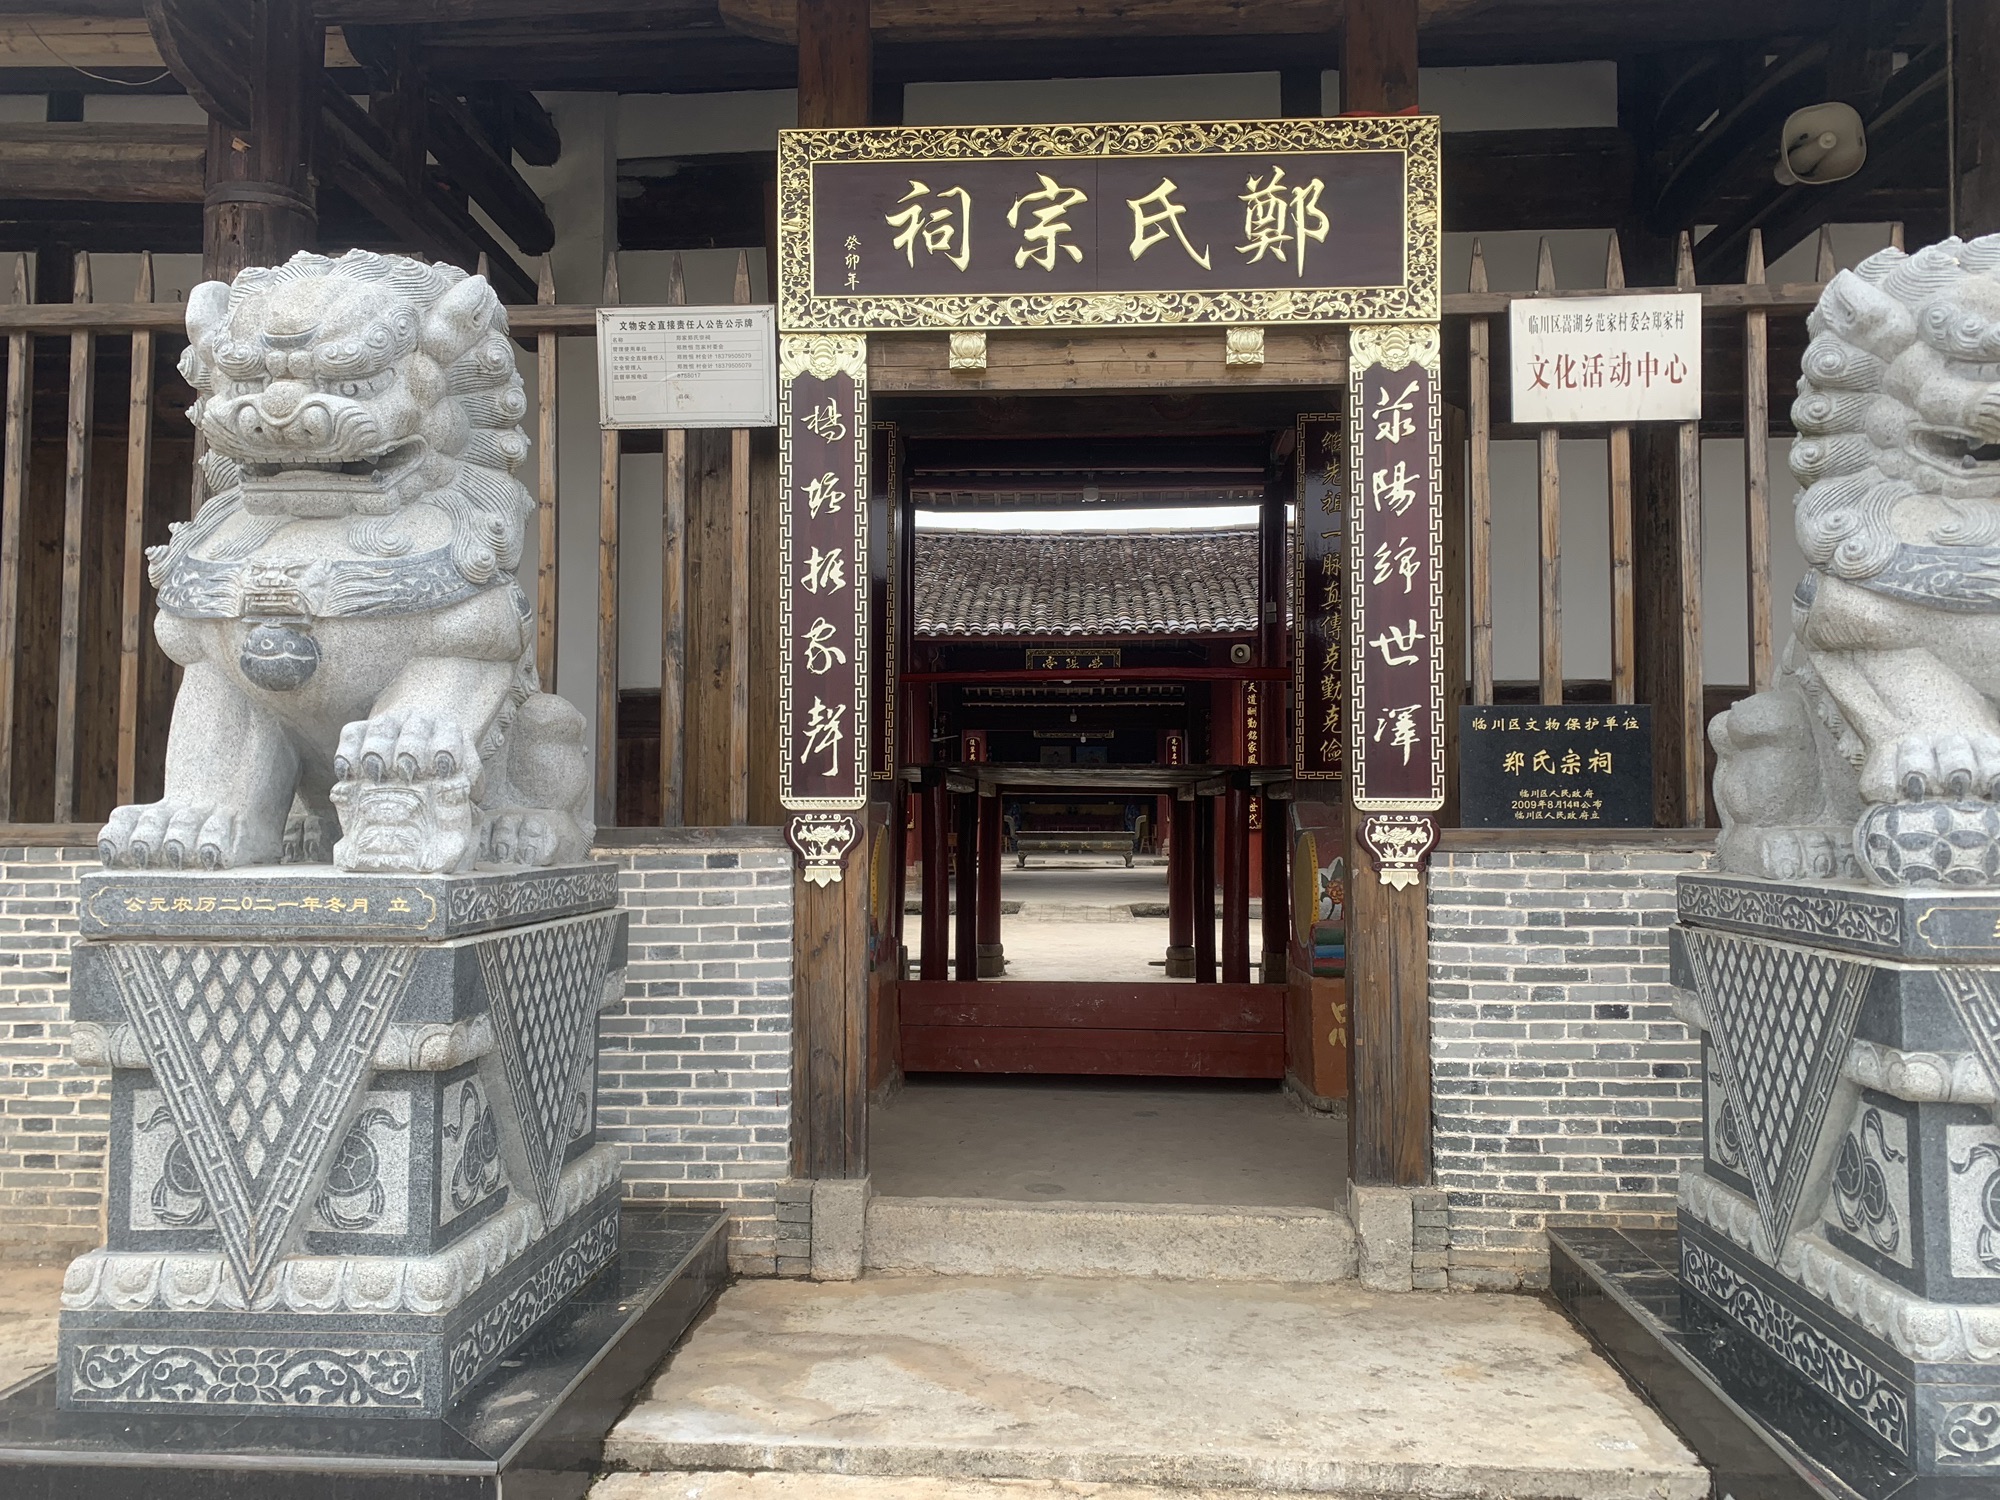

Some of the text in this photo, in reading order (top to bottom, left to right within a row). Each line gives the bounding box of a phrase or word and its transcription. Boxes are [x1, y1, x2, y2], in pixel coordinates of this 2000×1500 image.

[843, 234, 862, 292] 癸卯年
[619, 318, 754, 332] 文物安全直接责任人公告公示牌
[1528, 310, 1685, 335] 临川区嵩湖乡范家村委会郑家村
[1527, 352, 1688, 391] 文化活动中心
[1472, 715, 1640, 732] 临川区文物保护单位
[1503, 748, 1613, 776] 郑氏宗祠
[1519, 788, 1595, 799] 临川区人民政府
[1511, 799, 1603, 810] 2009年8月14日公布
[1514, 810, 1600, 821] 临川区人民政府立
[388, 897, 411, 914] 立
